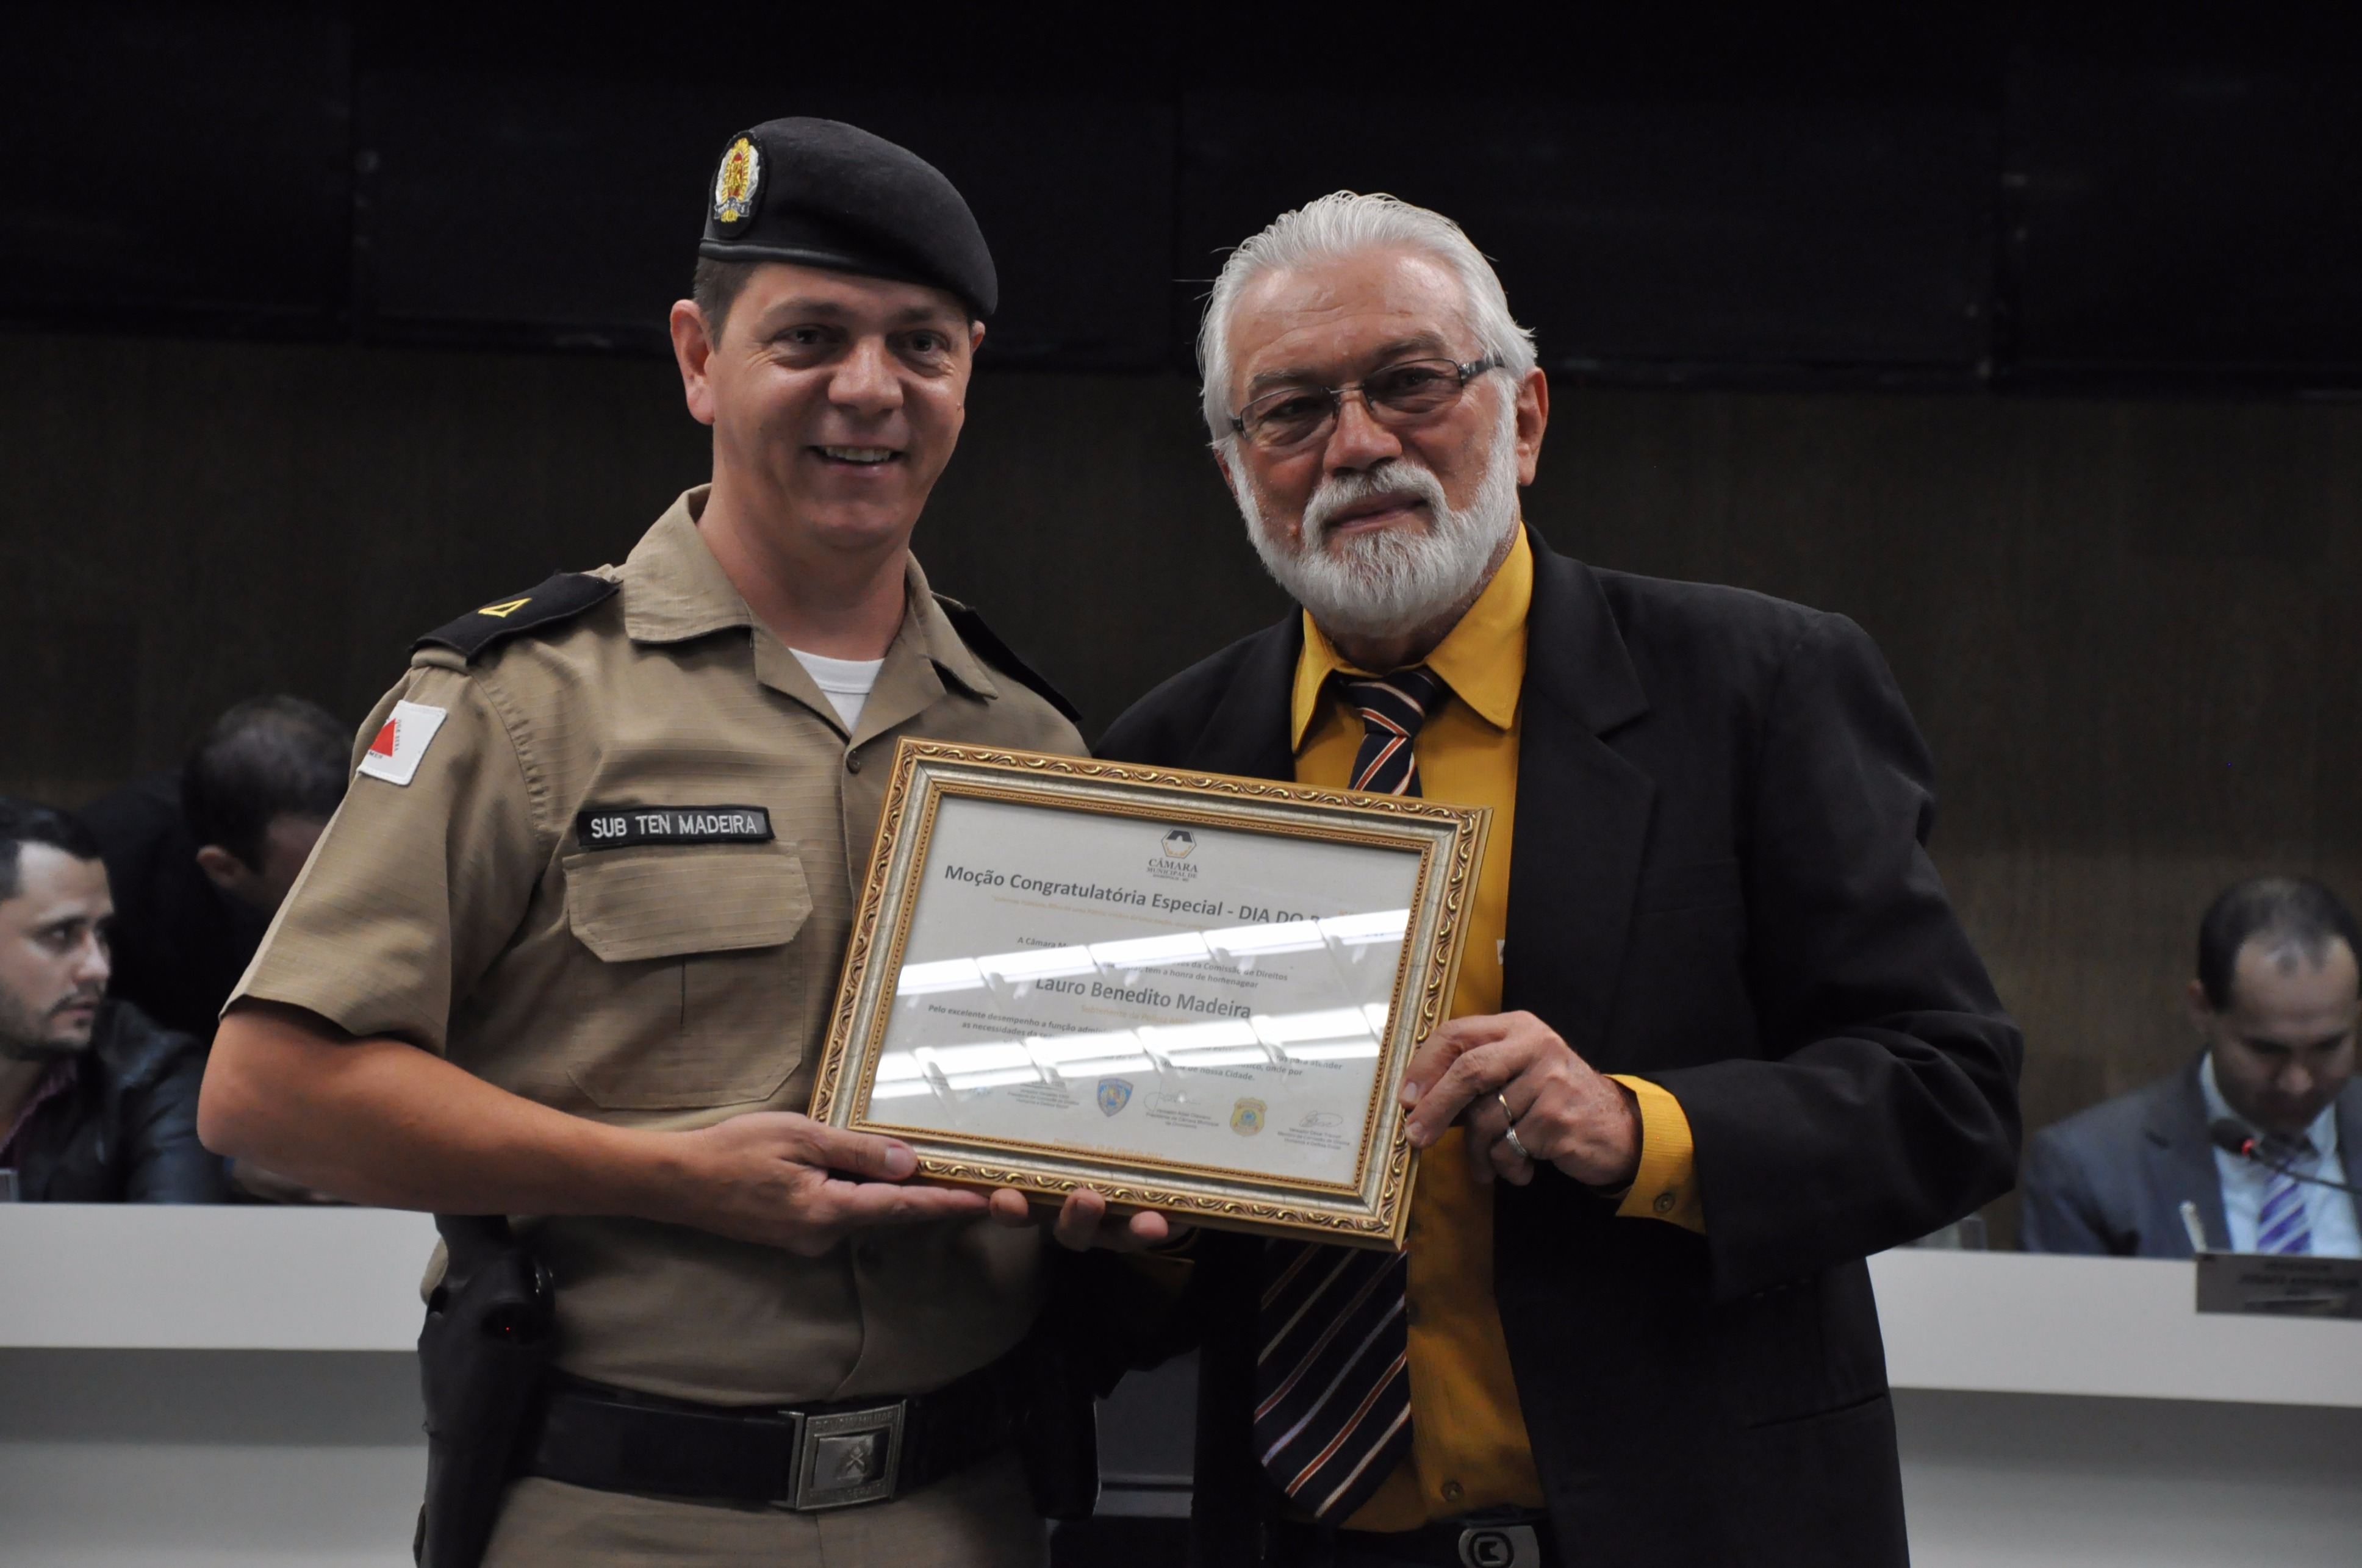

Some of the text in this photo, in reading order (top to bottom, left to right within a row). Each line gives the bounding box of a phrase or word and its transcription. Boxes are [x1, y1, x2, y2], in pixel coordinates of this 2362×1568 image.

[590, 814, 758, 839] SUB TEN MADEIRA
[1146, 867, 1186, 877] MUNICIPAL
[1148, 857, 1198, 873] CÂMARA
[945, 865, 1005, 886] Moção
[1009, 874, 1146, 906] Congratulatória
[1151, 893, 1223, 916] Especial
[1238, 906, 1269, 923] DIA
[1025, 937, 1055, 948] Câmara
[1169, 969, 1193, 979] honra
[1207, 974, 1258, 988] homenagear
[1256, 970, 1288, 981] Direitos
[1036, 978, 1252, 1019] Lauro Benedito Madeira
[928, 1004, 946, 1014] Pelo
[947, 1008, 986, 1019] excelente
[988, 1012, 1039, 1026] desempenho
[1048, 1021, 1076, 1031] função
[972, 1023, 1025, 1036] necessidades
[1266, 1064, 1287, 1073] onde
[1310, 1058, 1343, 1070] atender
[1200, 1067, 1222, 1076] nossa
[1225, 1070, 1255, 1081] Cidade.
